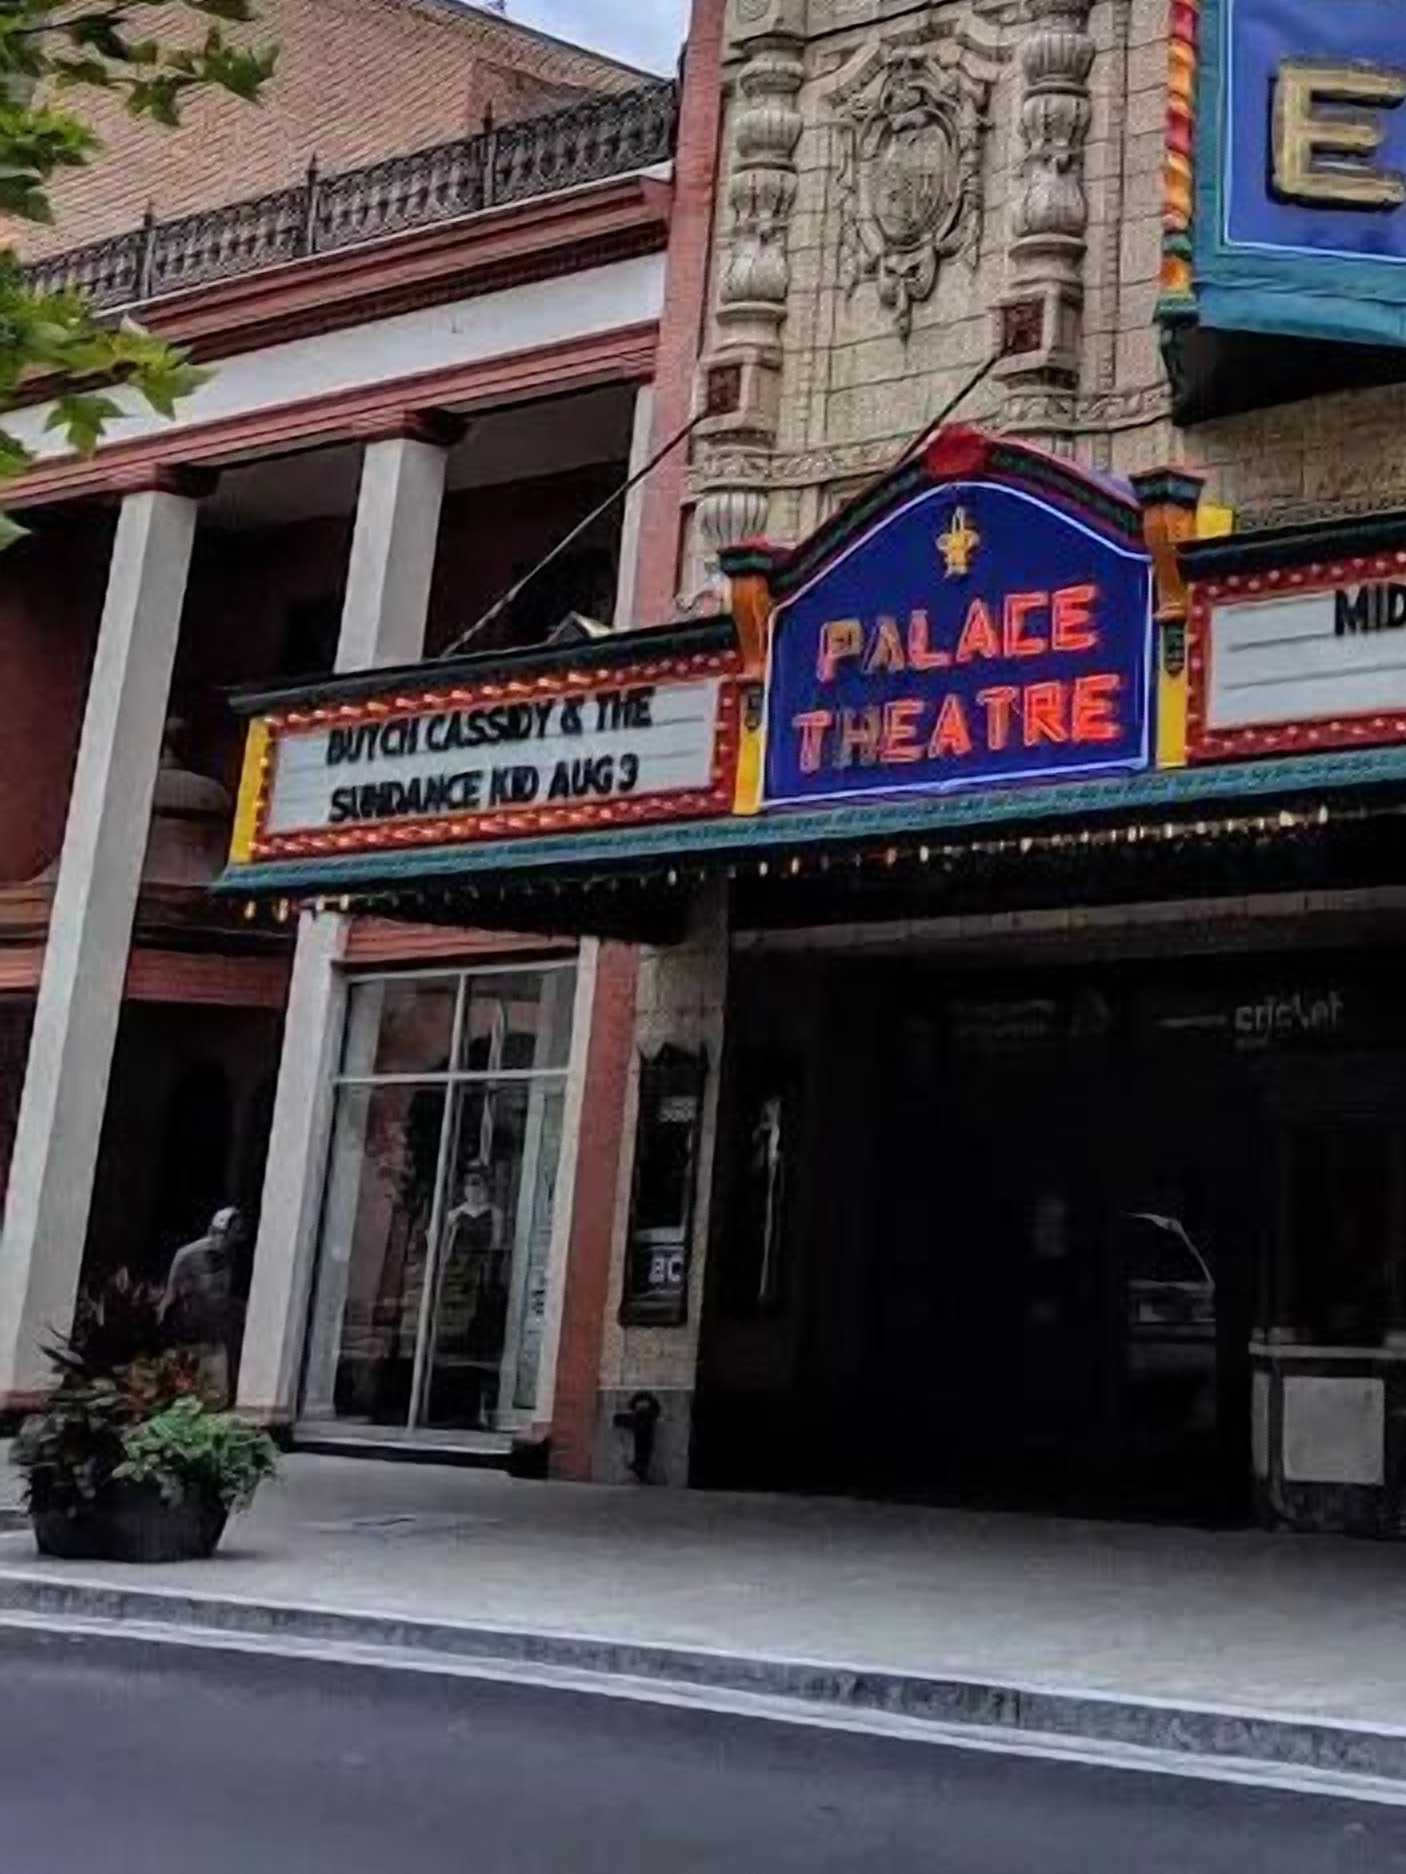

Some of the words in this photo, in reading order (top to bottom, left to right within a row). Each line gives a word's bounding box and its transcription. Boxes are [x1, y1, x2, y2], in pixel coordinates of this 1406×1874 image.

[815, 583, 1100, 683] PALACE
[326, 716, 421, 766] BUTCH
[425, 698, 557, 751] CASSIDY
[560, 694, 584, 736] &
[596, 686, 657, 732] THE
[791, 673, 1123, 775] THEATRE
[328, 769, 484, 823] SUNDANCE
[489, 765, 540, 807] KID
[548, 755, 615, 801] AUG
[618, 752, 640, 792] 3
